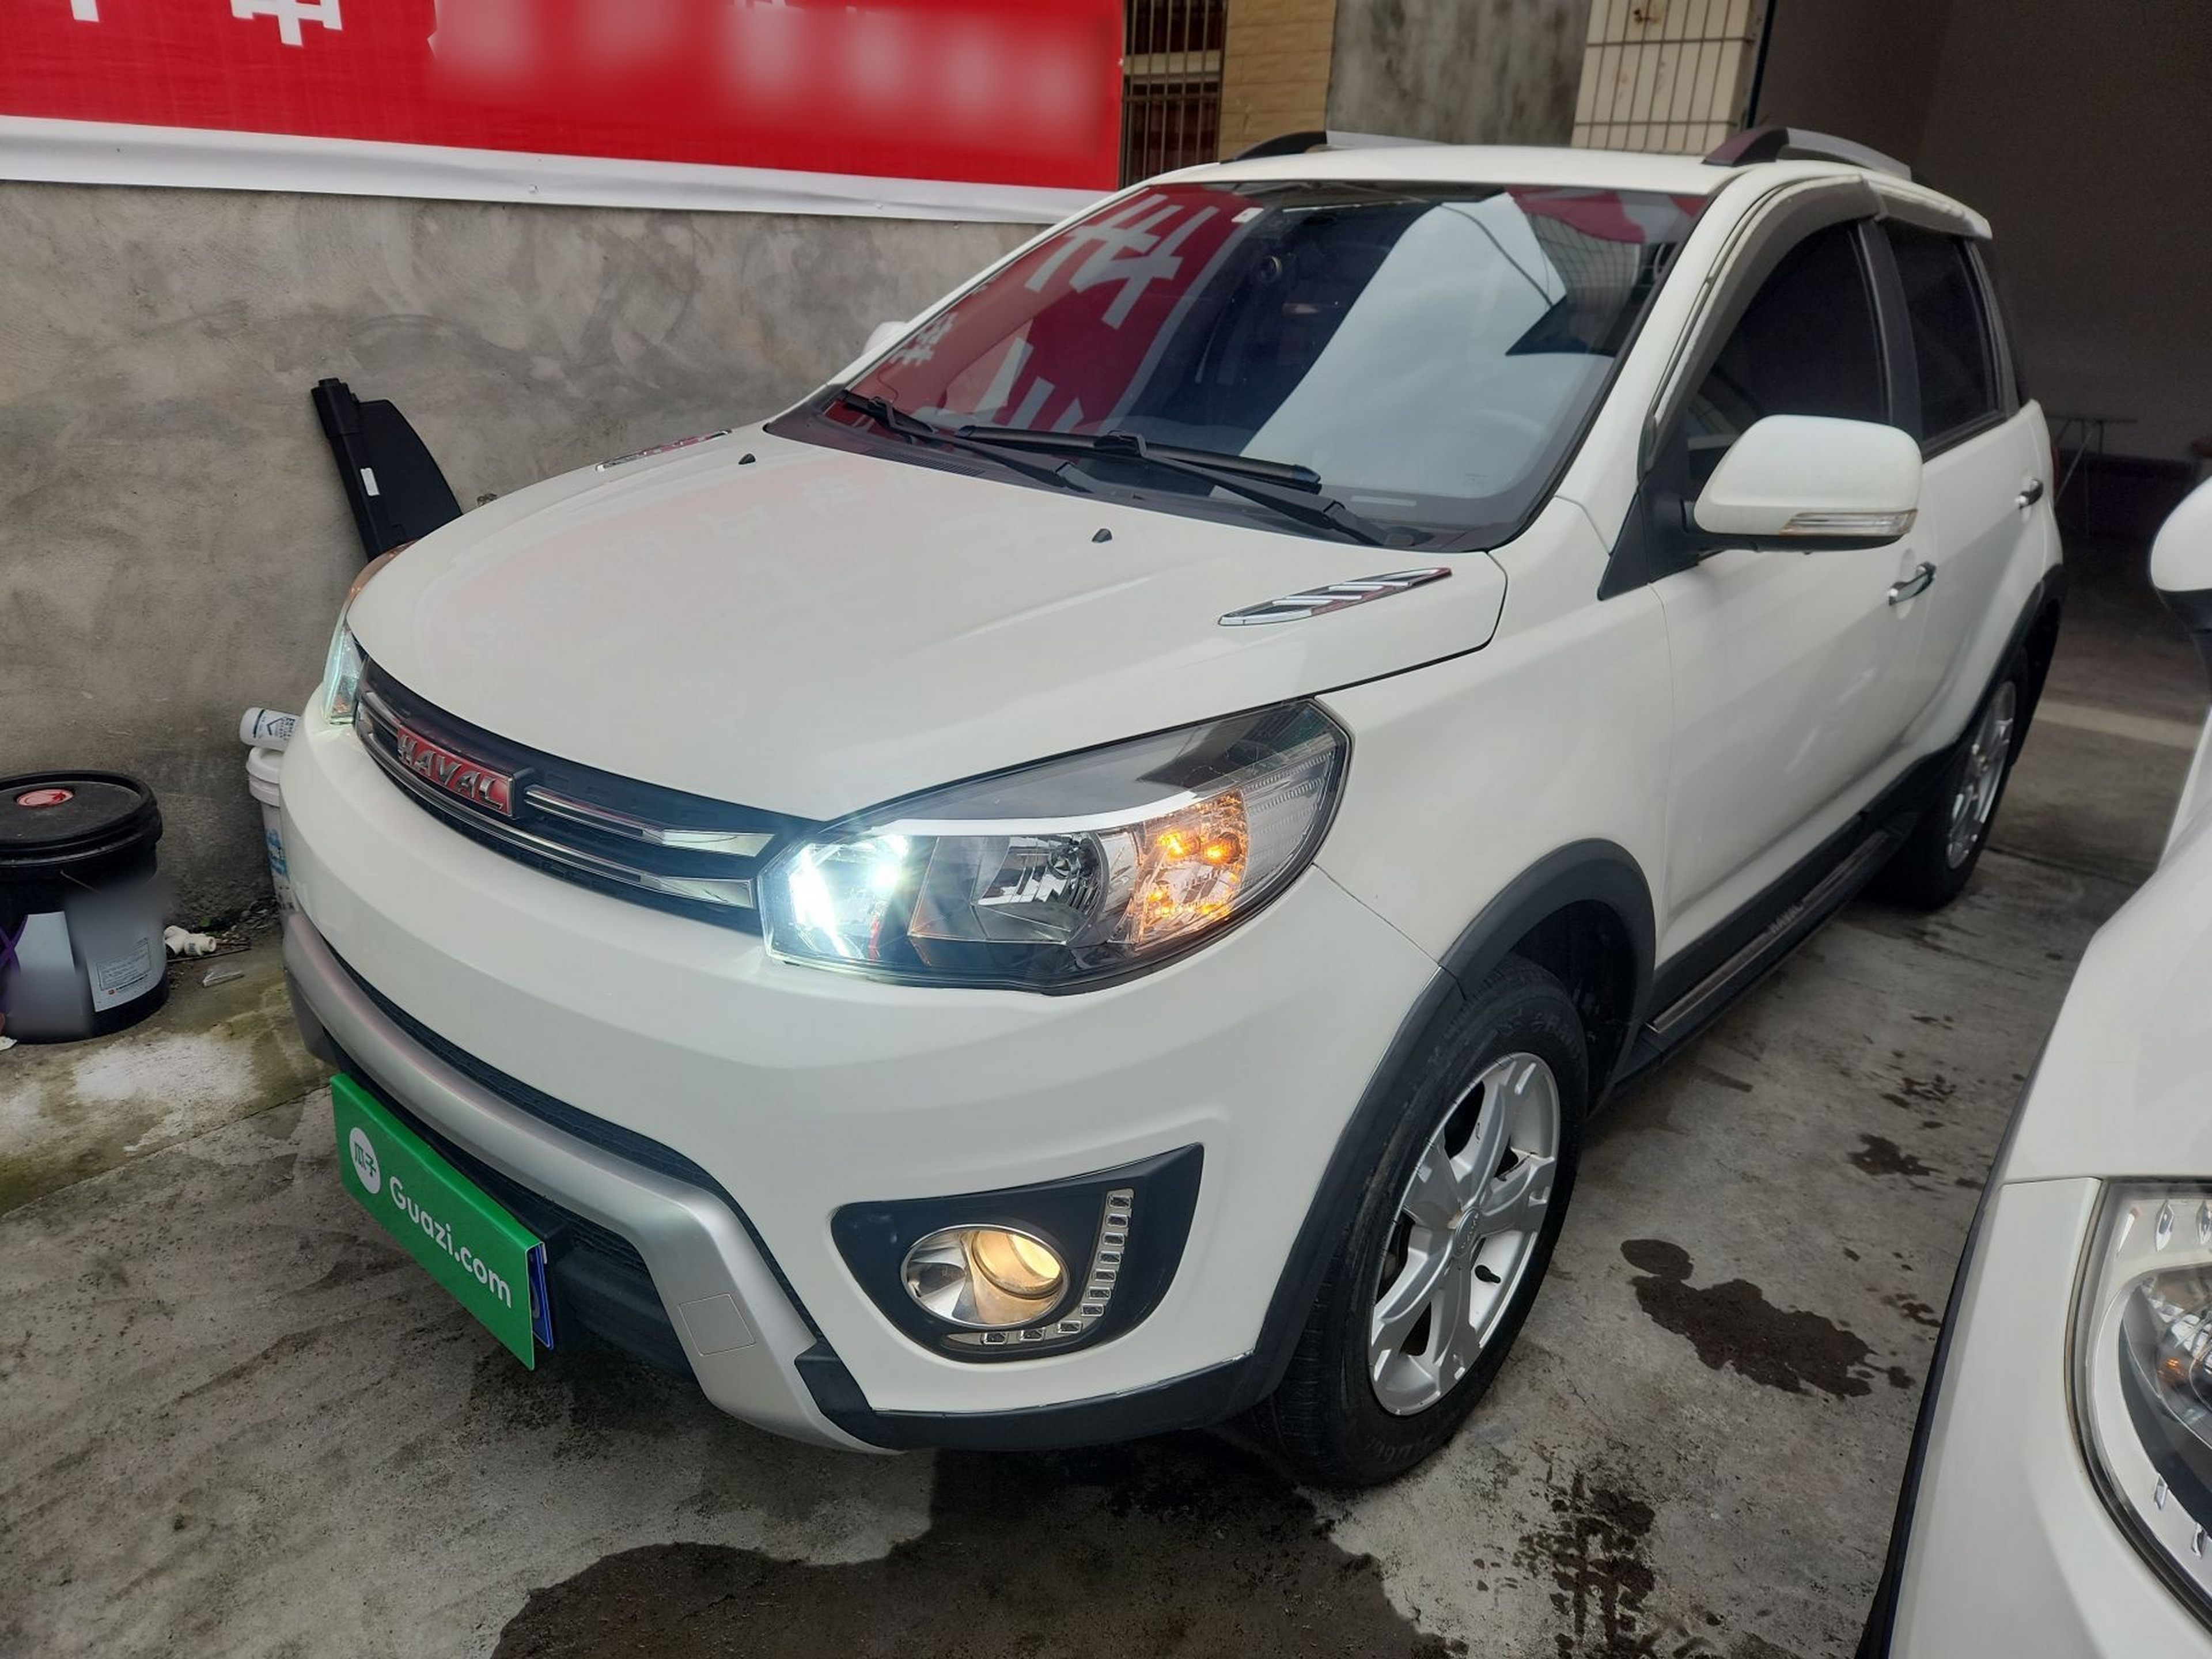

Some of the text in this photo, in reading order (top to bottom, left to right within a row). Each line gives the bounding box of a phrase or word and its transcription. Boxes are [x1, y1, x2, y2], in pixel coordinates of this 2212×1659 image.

[397, 735, 503, 809] HAVAL
[354, 1142, 376, 1177] 瓜子
[389, 1176, 512, 1309] Guazi.com
